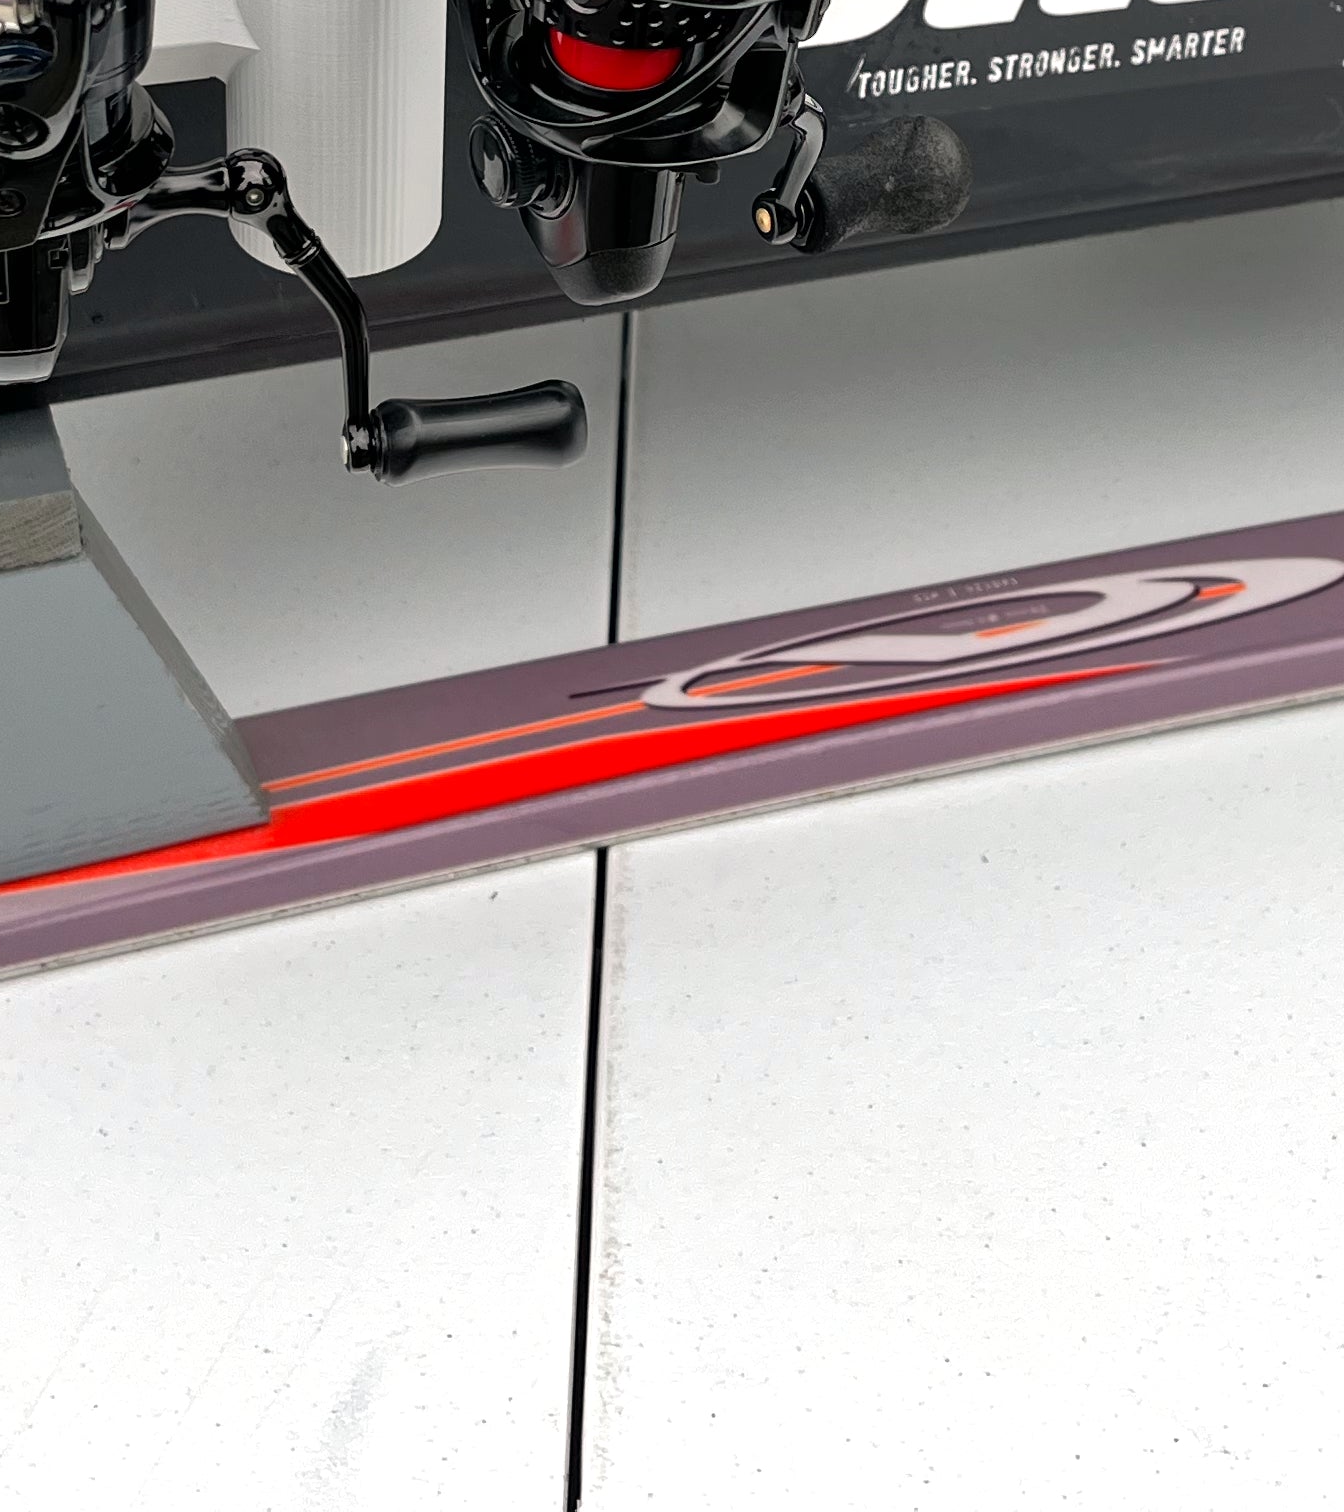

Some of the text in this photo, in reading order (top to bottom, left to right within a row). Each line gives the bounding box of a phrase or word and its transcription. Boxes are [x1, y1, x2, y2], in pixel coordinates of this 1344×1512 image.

[856, 26, 1246, 99] TOUGHER. STRONGER. SMARTER
